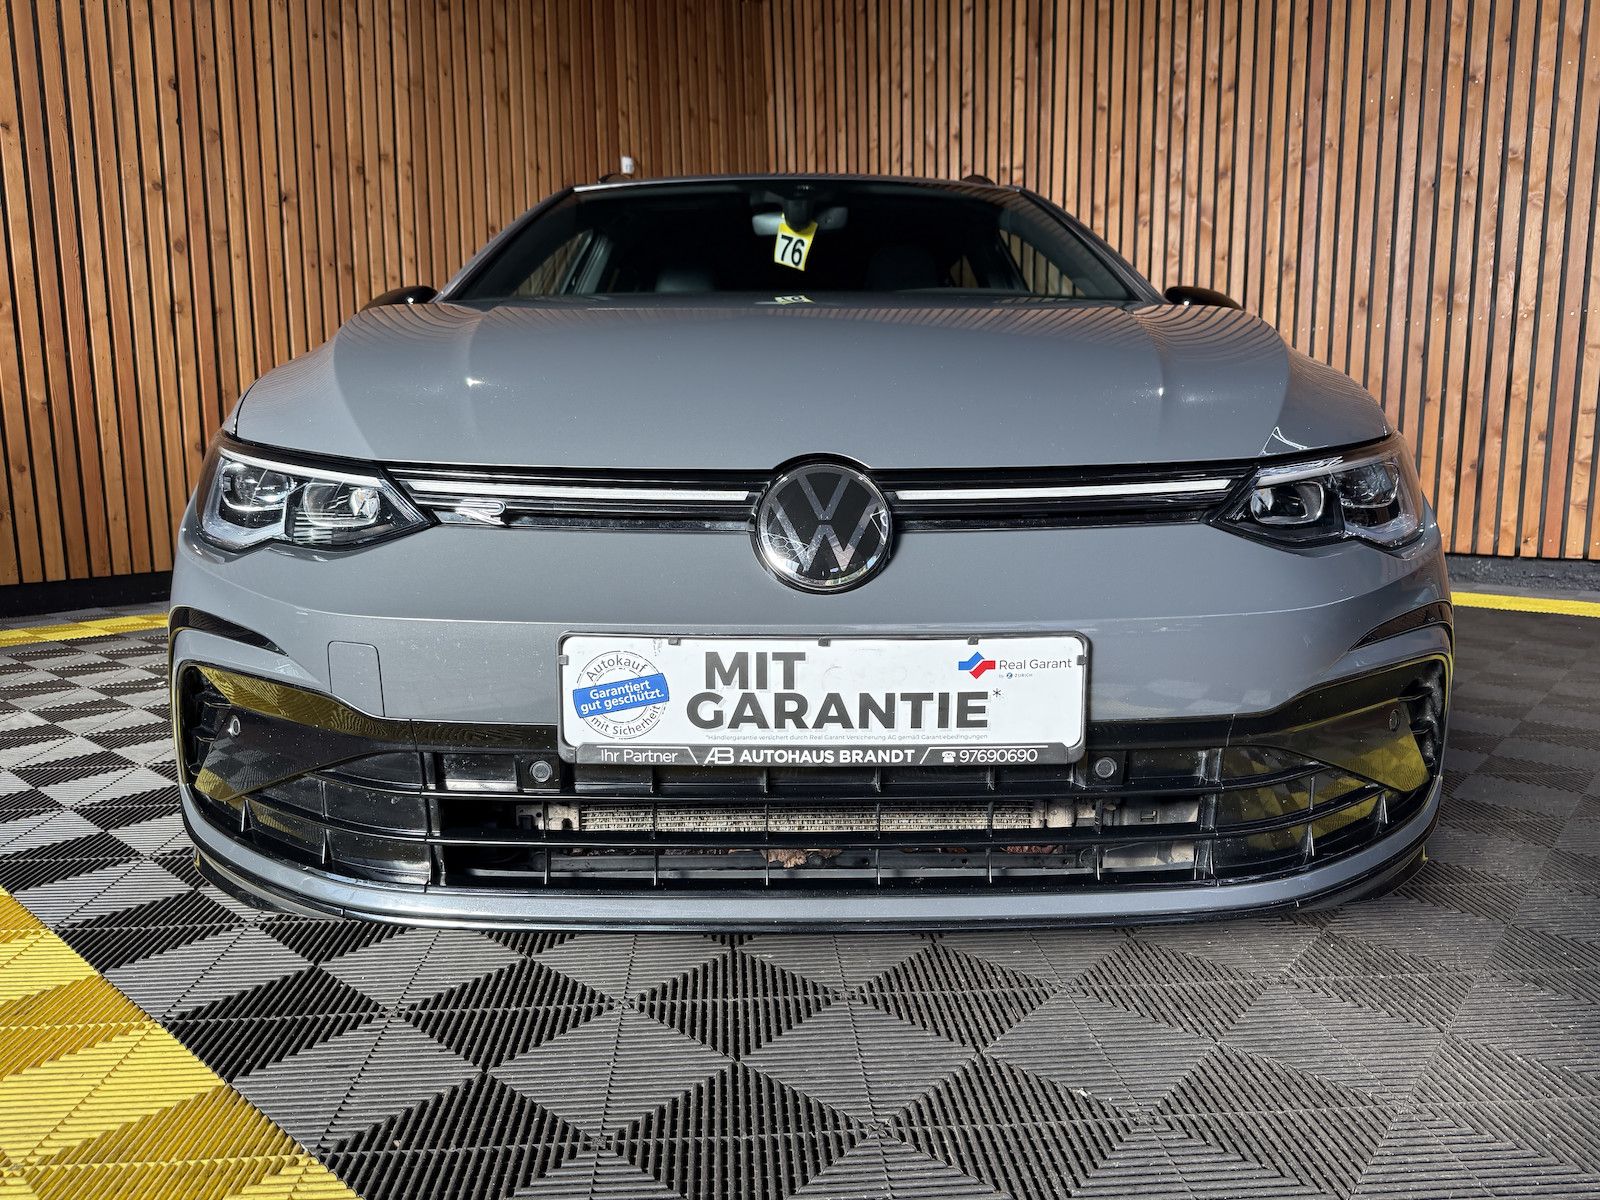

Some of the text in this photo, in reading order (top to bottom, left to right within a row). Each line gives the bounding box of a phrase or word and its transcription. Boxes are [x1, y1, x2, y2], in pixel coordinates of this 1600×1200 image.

[781, 234, 805, 266] 76
[763, 469, 883, 574] VW
[586, 654, 648, 682] Autokauf
[704, 651, 806, 690] MIT
[999, 658, 1072, 670] Real Garant
[580, 686, 665, 716] gut geschützt.
[589, 680, 651, 700] Garantiert
[590, 705, 661, 736] mit Sicherheit
[600, 749, 620, 763] Ihr
[623, 749, 679, 763] Partner
[739, 749, 835, 764] AUTOHAUS
[839, 748, 916, 764] BRANDT
[959, 748, 1038, 763] 97690690
